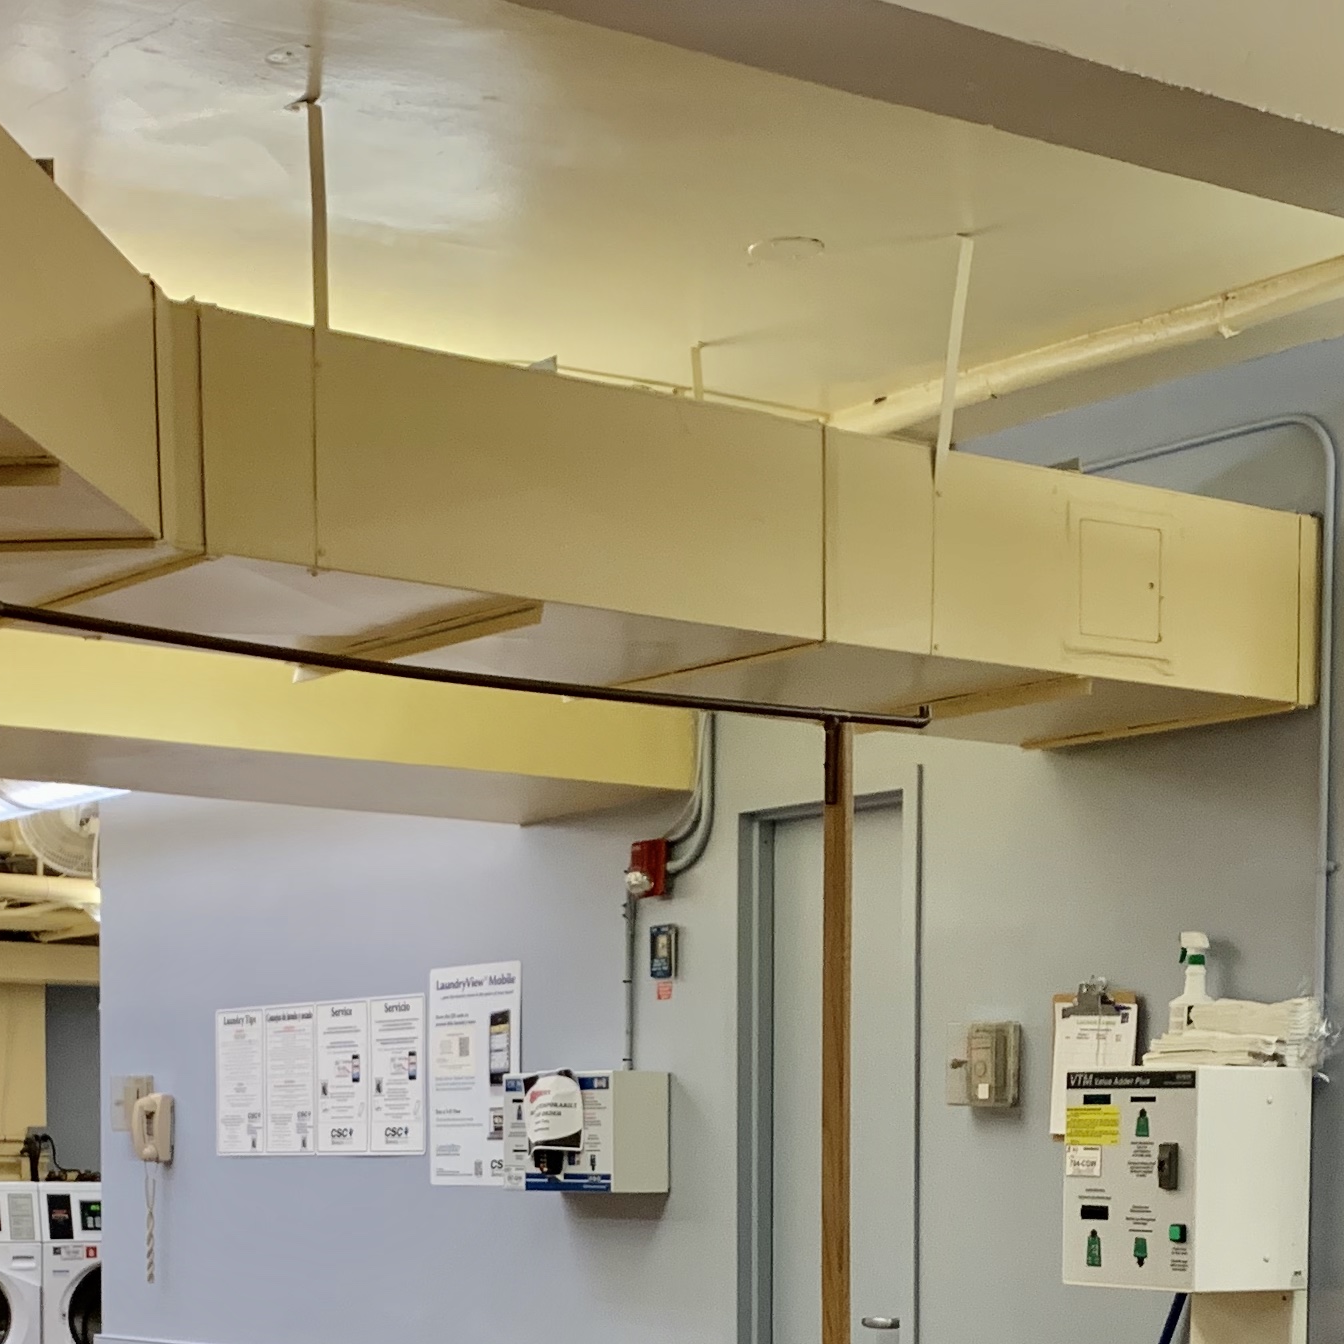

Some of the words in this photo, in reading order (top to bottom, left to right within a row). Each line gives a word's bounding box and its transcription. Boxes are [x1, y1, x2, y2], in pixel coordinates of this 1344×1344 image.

[331, 1006, 353, 1018] Service
[1070, 1074, 1093, 1086] VTM
[1134, 1076, 1150, 1085] Plus
[331, 1128, 348, 1138] CSC
[385, 1126, 403, 1137] CSC
